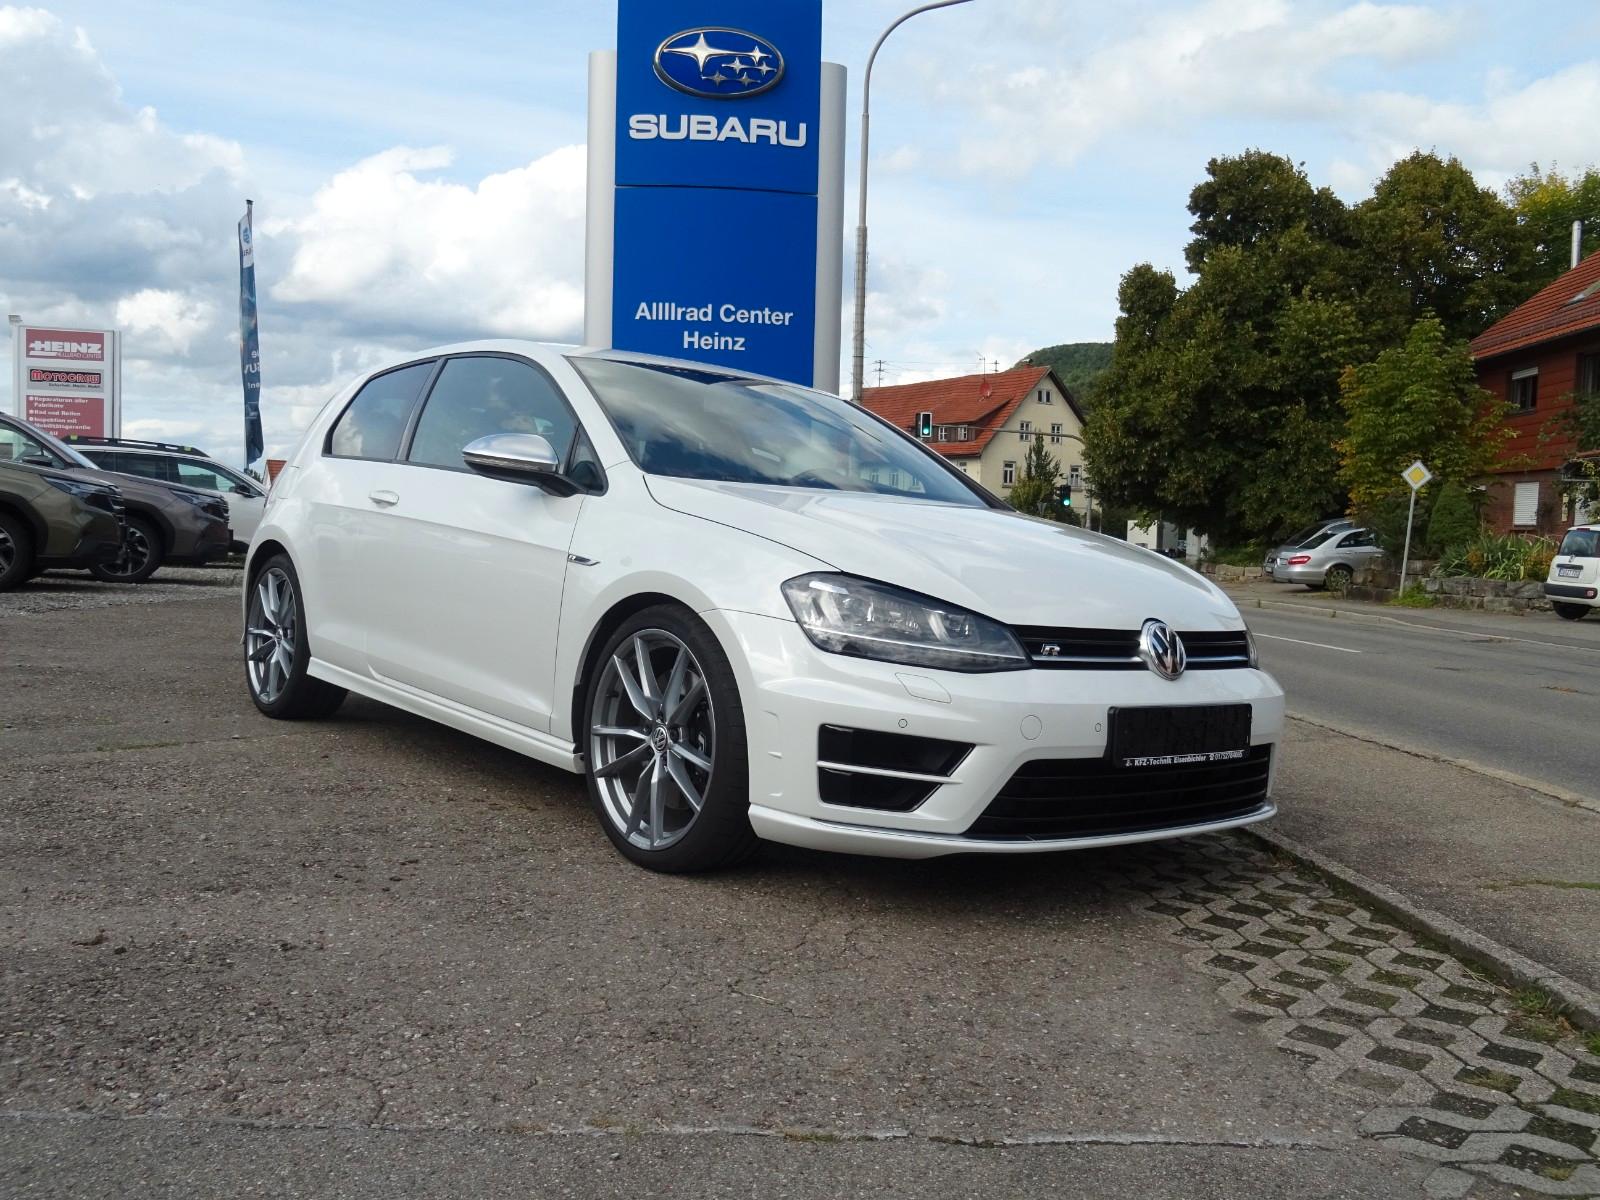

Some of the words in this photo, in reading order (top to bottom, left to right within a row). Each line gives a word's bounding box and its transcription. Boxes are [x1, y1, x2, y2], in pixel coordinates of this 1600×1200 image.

[628, 113, 807, 148] SUBARU
[719, 303, 794, 326] Center
[29, 340, 101, 353] HEINZ
[683, 331, 746, 351] Heinz
[1041, 643, 1061, 656] R
